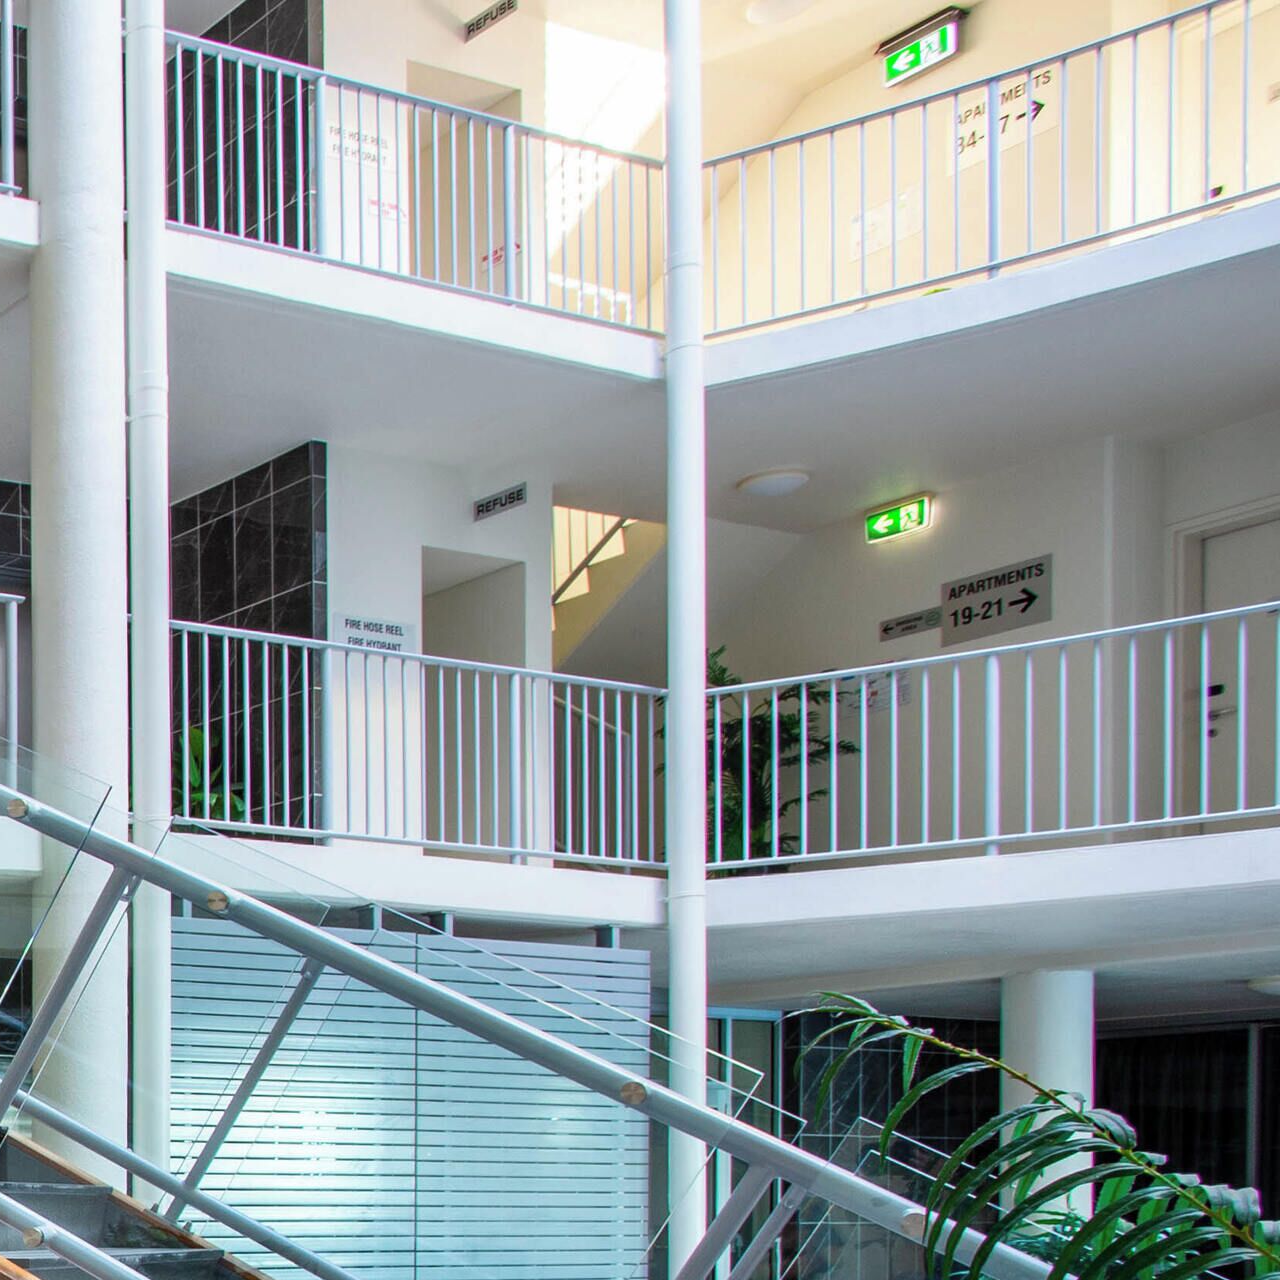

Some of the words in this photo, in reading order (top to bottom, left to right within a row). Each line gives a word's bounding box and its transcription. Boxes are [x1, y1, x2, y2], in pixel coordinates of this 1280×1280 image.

[467, 0, 515, 36] REFUSE
[957, 113, 1011, 155] 34-7
[476, 488, 524, 517] REFUSE
[948, 563, 1045, 601] APARTMENTS
[344, 618, 361, 631] FIRE
[363, 621, 383, 634] HOSE
[385, 624, 404, 637] REEL
[949, 598, 1004, 628] 19-21
[366, 639, 402, 652] HYDRANT
